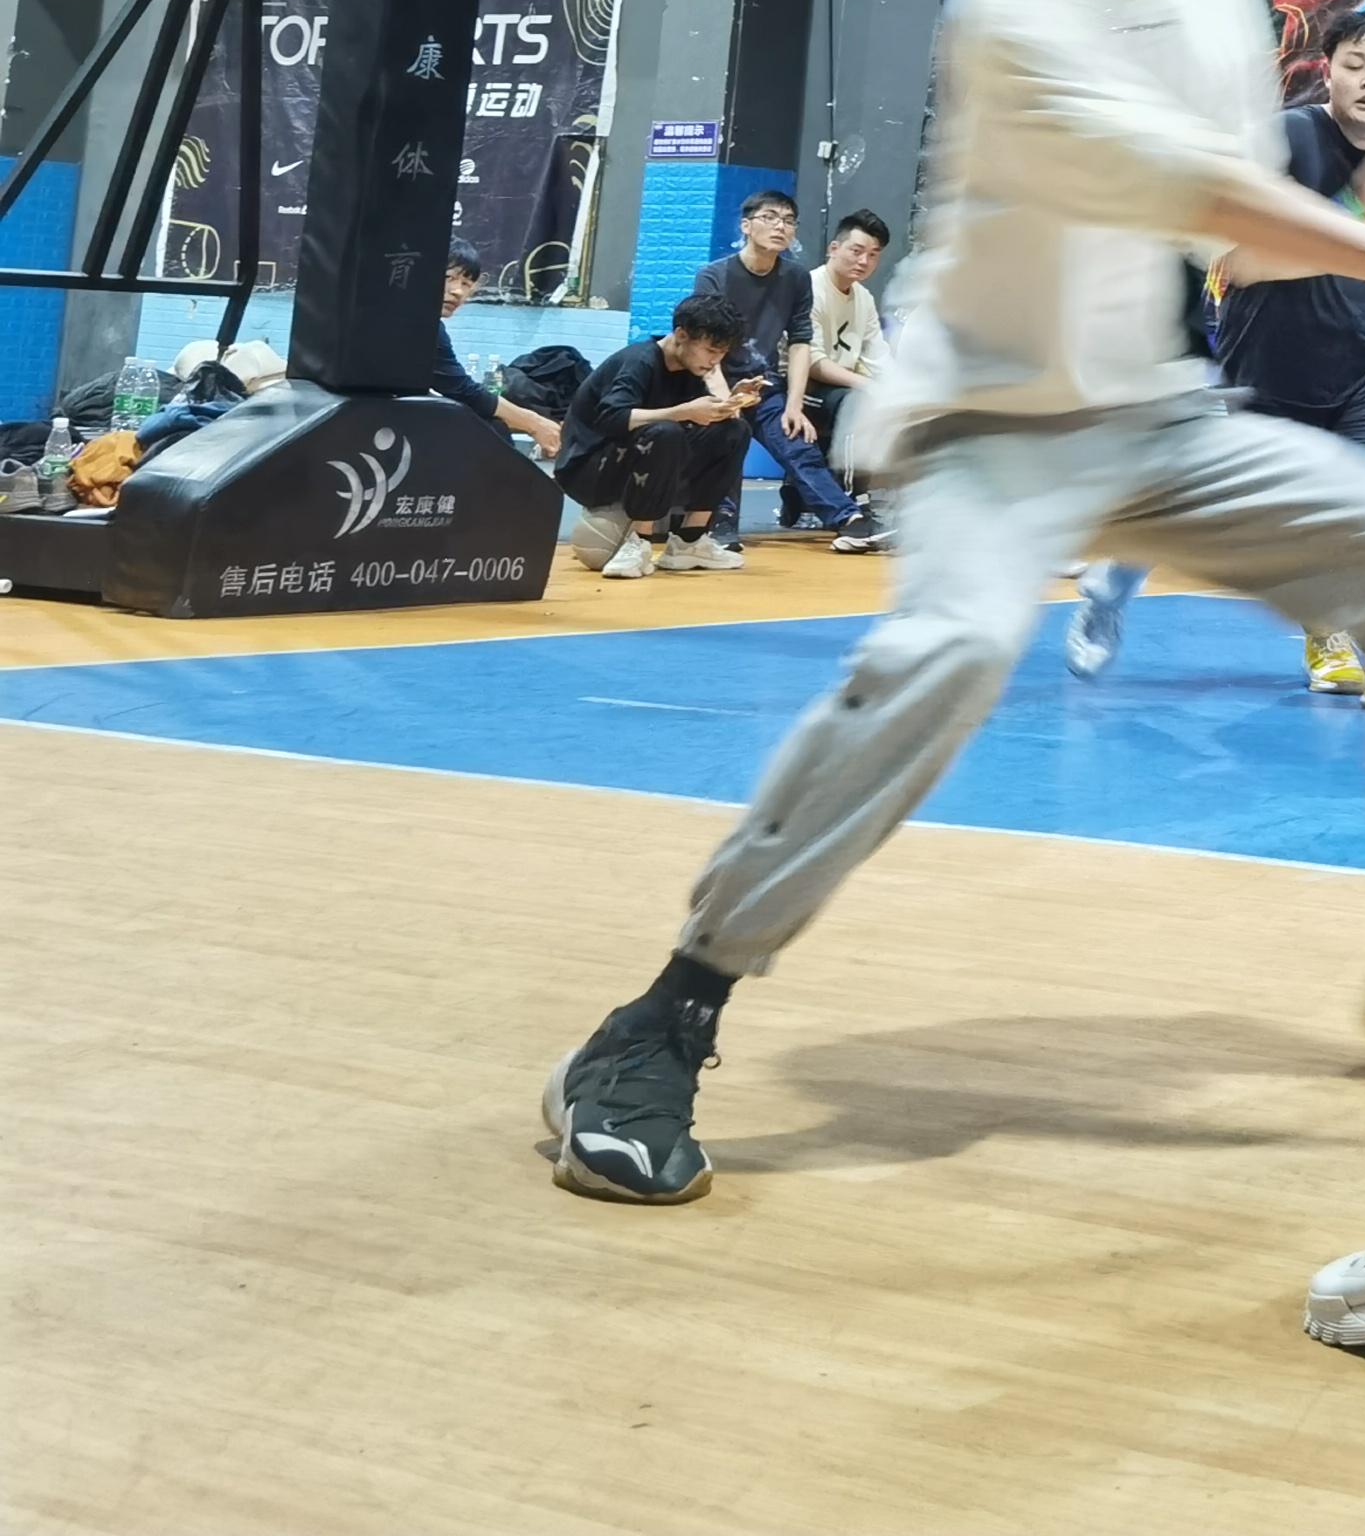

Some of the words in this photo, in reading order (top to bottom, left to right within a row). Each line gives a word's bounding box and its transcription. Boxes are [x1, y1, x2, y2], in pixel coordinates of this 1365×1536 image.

[466, 82, 543, 118] 运动
[395, 494, 456, 515] 宏康健
[218, 562, 336, 598] 售后电话
[350, 556, 525, 588] 400-047-0006
